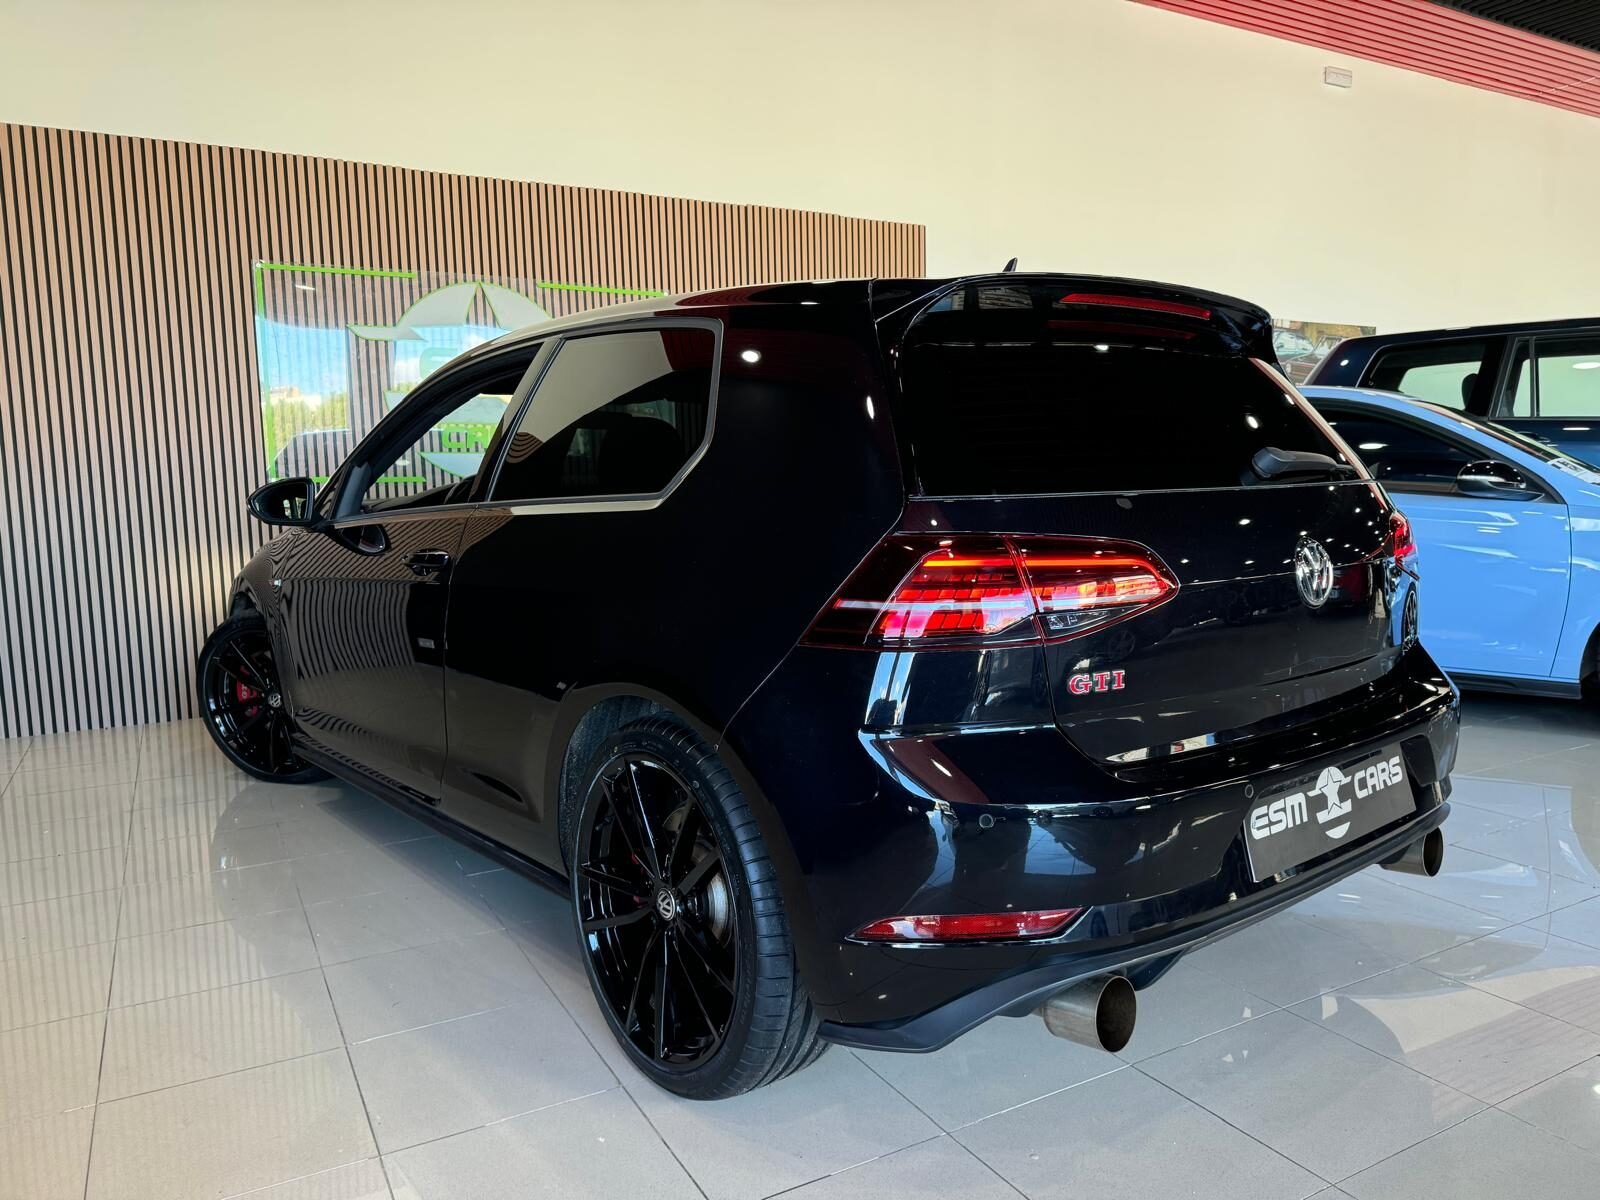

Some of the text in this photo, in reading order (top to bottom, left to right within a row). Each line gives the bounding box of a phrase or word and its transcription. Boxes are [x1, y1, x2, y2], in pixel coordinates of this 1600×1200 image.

[442, 425, 492, 448] CA
[1068, 669, 1125, 694] GTI
[1250, 756, 1403, 840] ESM CARS
